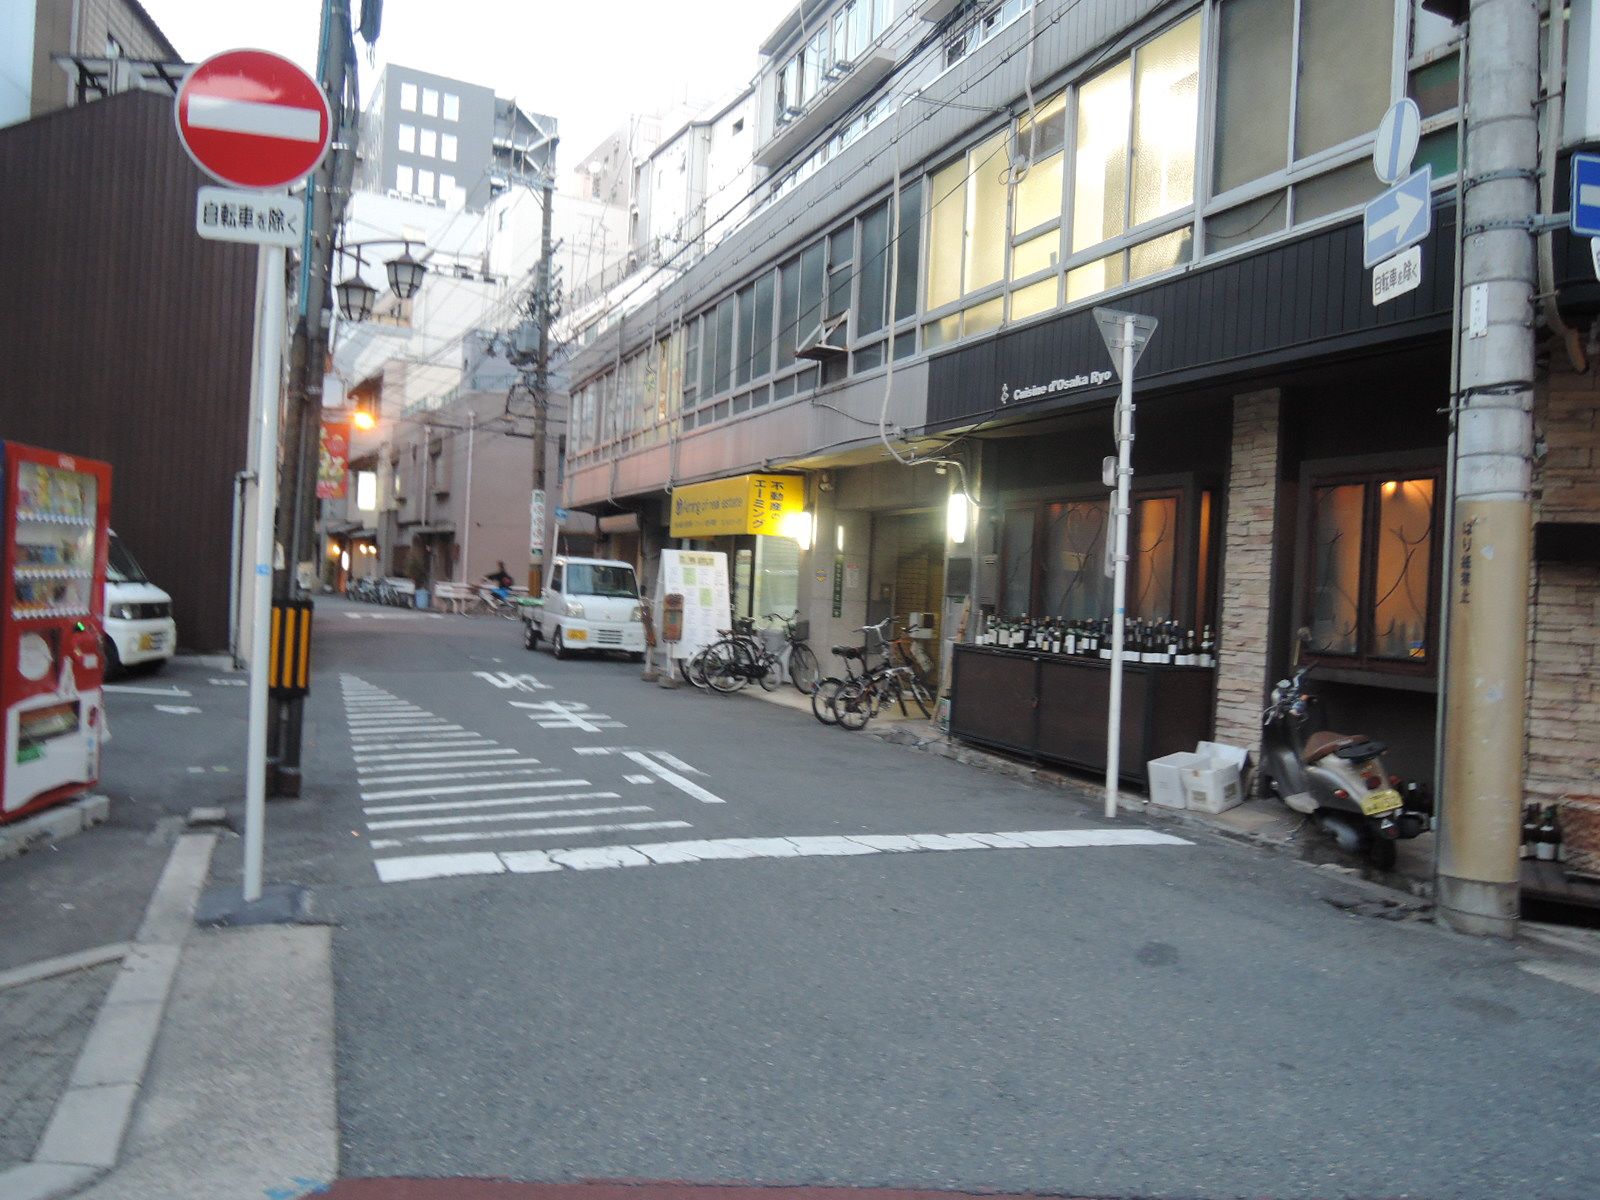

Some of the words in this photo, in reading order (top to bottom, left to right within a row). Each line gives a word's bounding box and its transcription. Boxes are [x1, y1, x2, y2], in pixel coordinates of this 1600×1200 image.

[203, 200, 297, 235] 自転車を除く
[1375, 260, 1418, 295] 自転車を除く
[1013, 385, 1048, 401] Cuisine
[1048, 375, 1089, 392] d'Osaka
[1090, 370, 1112, 386] Ryo
[752, 479, 767, 528] エーミング
